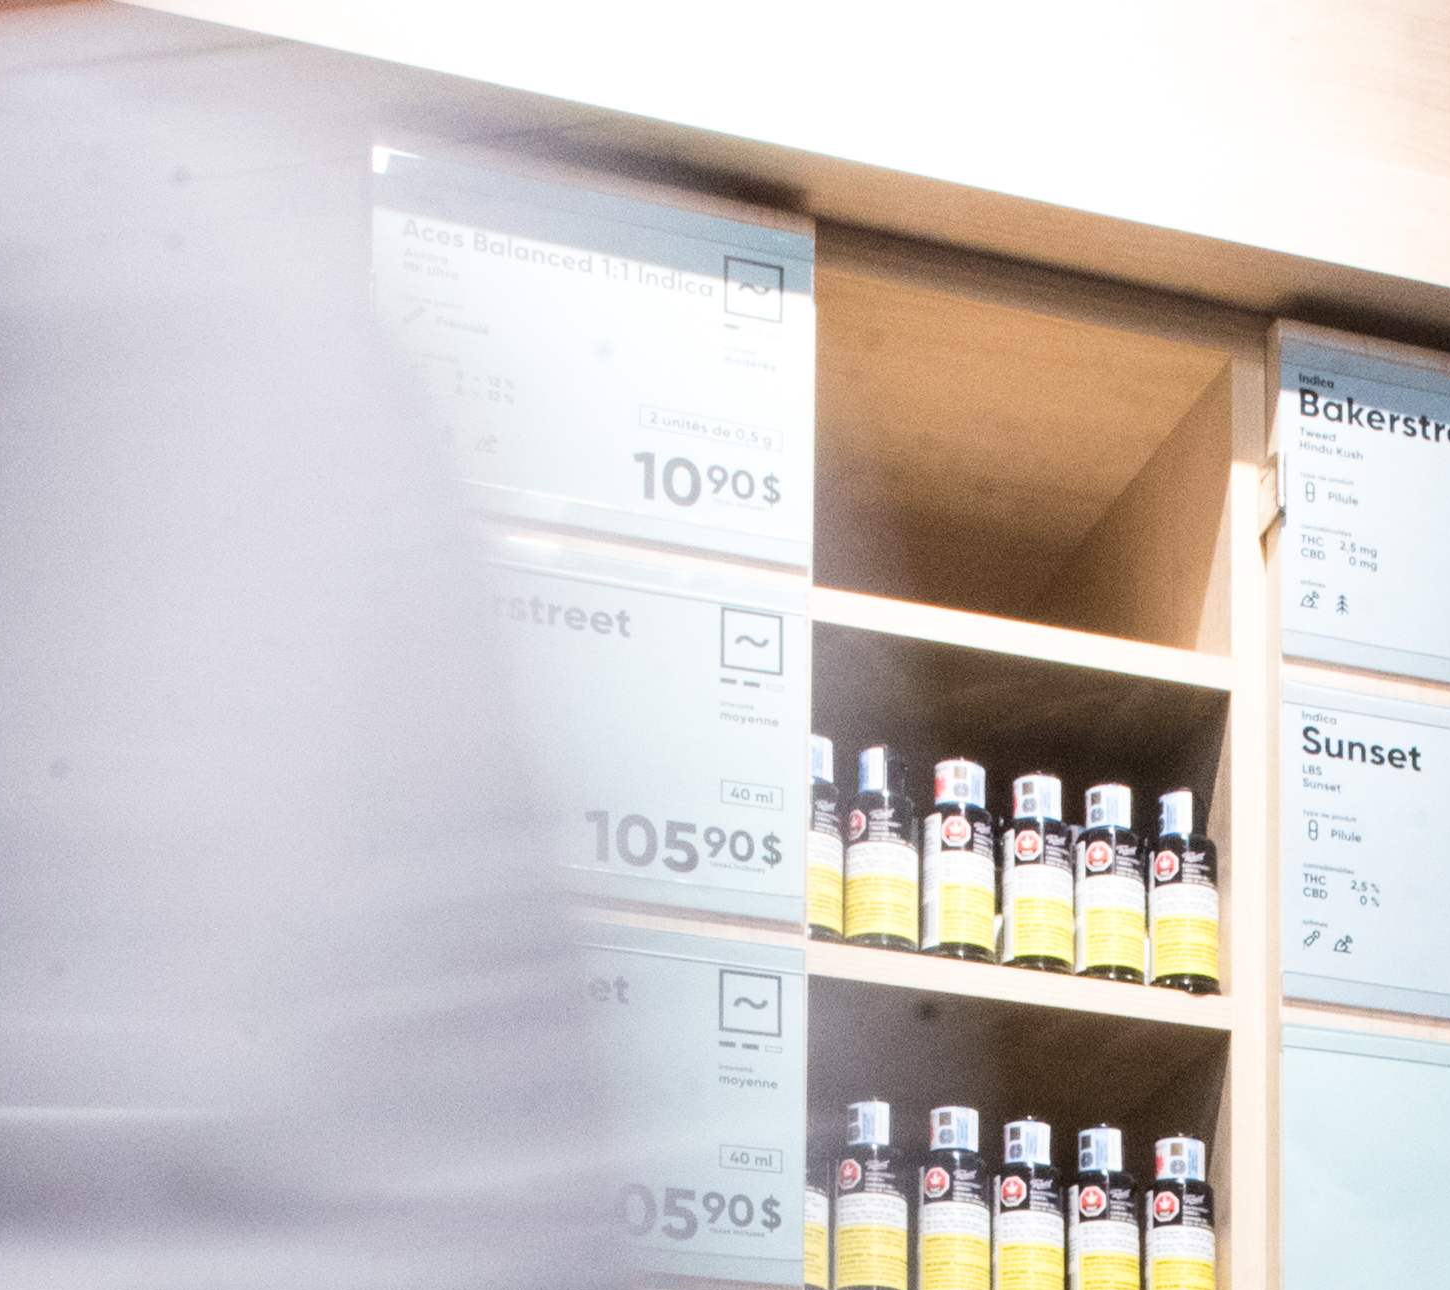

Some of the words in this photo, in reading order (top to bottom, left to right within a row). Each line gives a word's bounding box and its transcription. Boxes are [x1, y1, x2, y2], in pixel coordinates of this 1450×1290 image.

[403, 218, 465, 248] Aces
[473, 235, 593, 275] Balanced
[637, 264, 714, 299] Indica
[1299, 373, 1335, 389] Indica
[1300, 427, 1336, 442] Tweed
[1300, 440, 1332, 457] Hindu
[1336, 446, 1363, 461] Kush
[1328, 491, 1359, 506] Pilule
[493, 594, 631, 638] street
[1301, 711, 1337, 726] Indica
[1302, 726, 1421, 772] Sunset
[1302, 764, 1322, 777] LBS
[731, 785, 750, 801] 40
[1303, 778, 1341, 794] Sunset
